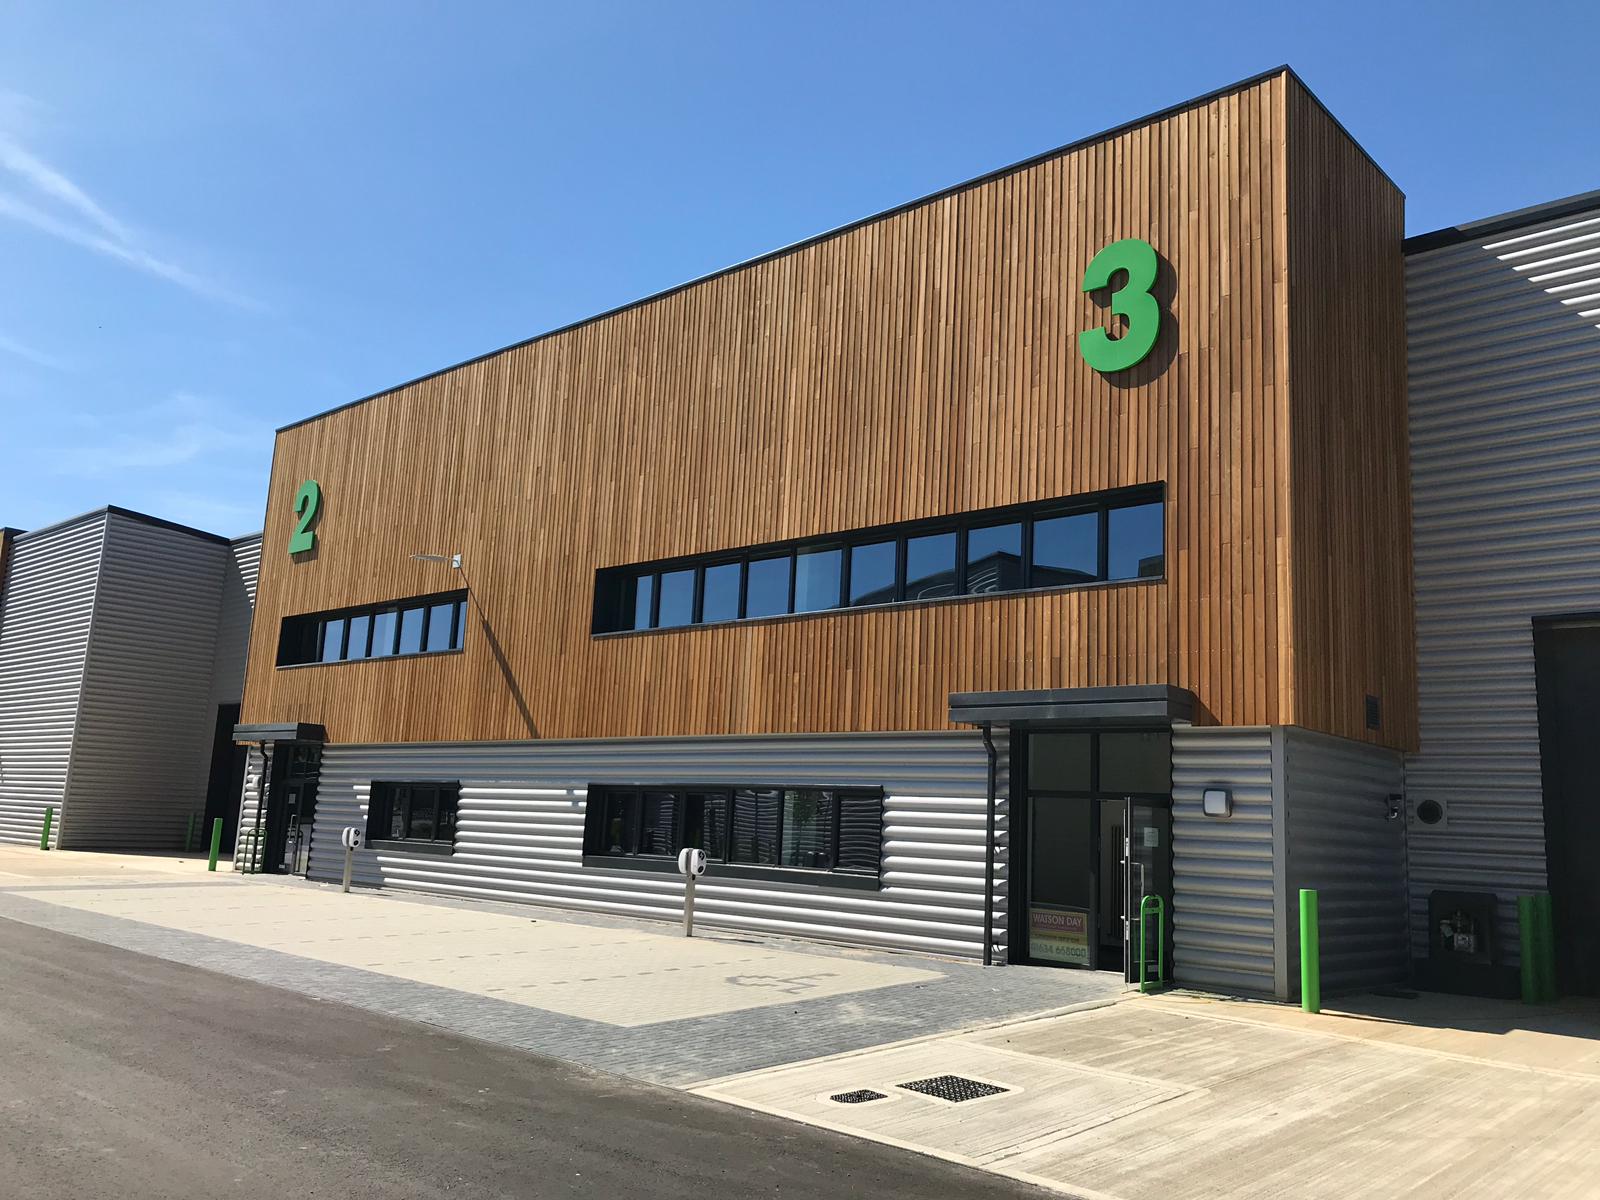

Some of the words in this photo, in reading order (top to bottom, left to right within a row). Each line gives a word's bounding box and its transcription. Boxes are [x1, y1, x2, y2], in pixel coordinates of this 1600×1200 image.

[1079, 238, 1160, 373] 3
[288, 480, 319, 554] 2
[1032, 913, 1065, 925] WATSON
[1066, 916, 1082, 927] DAY
